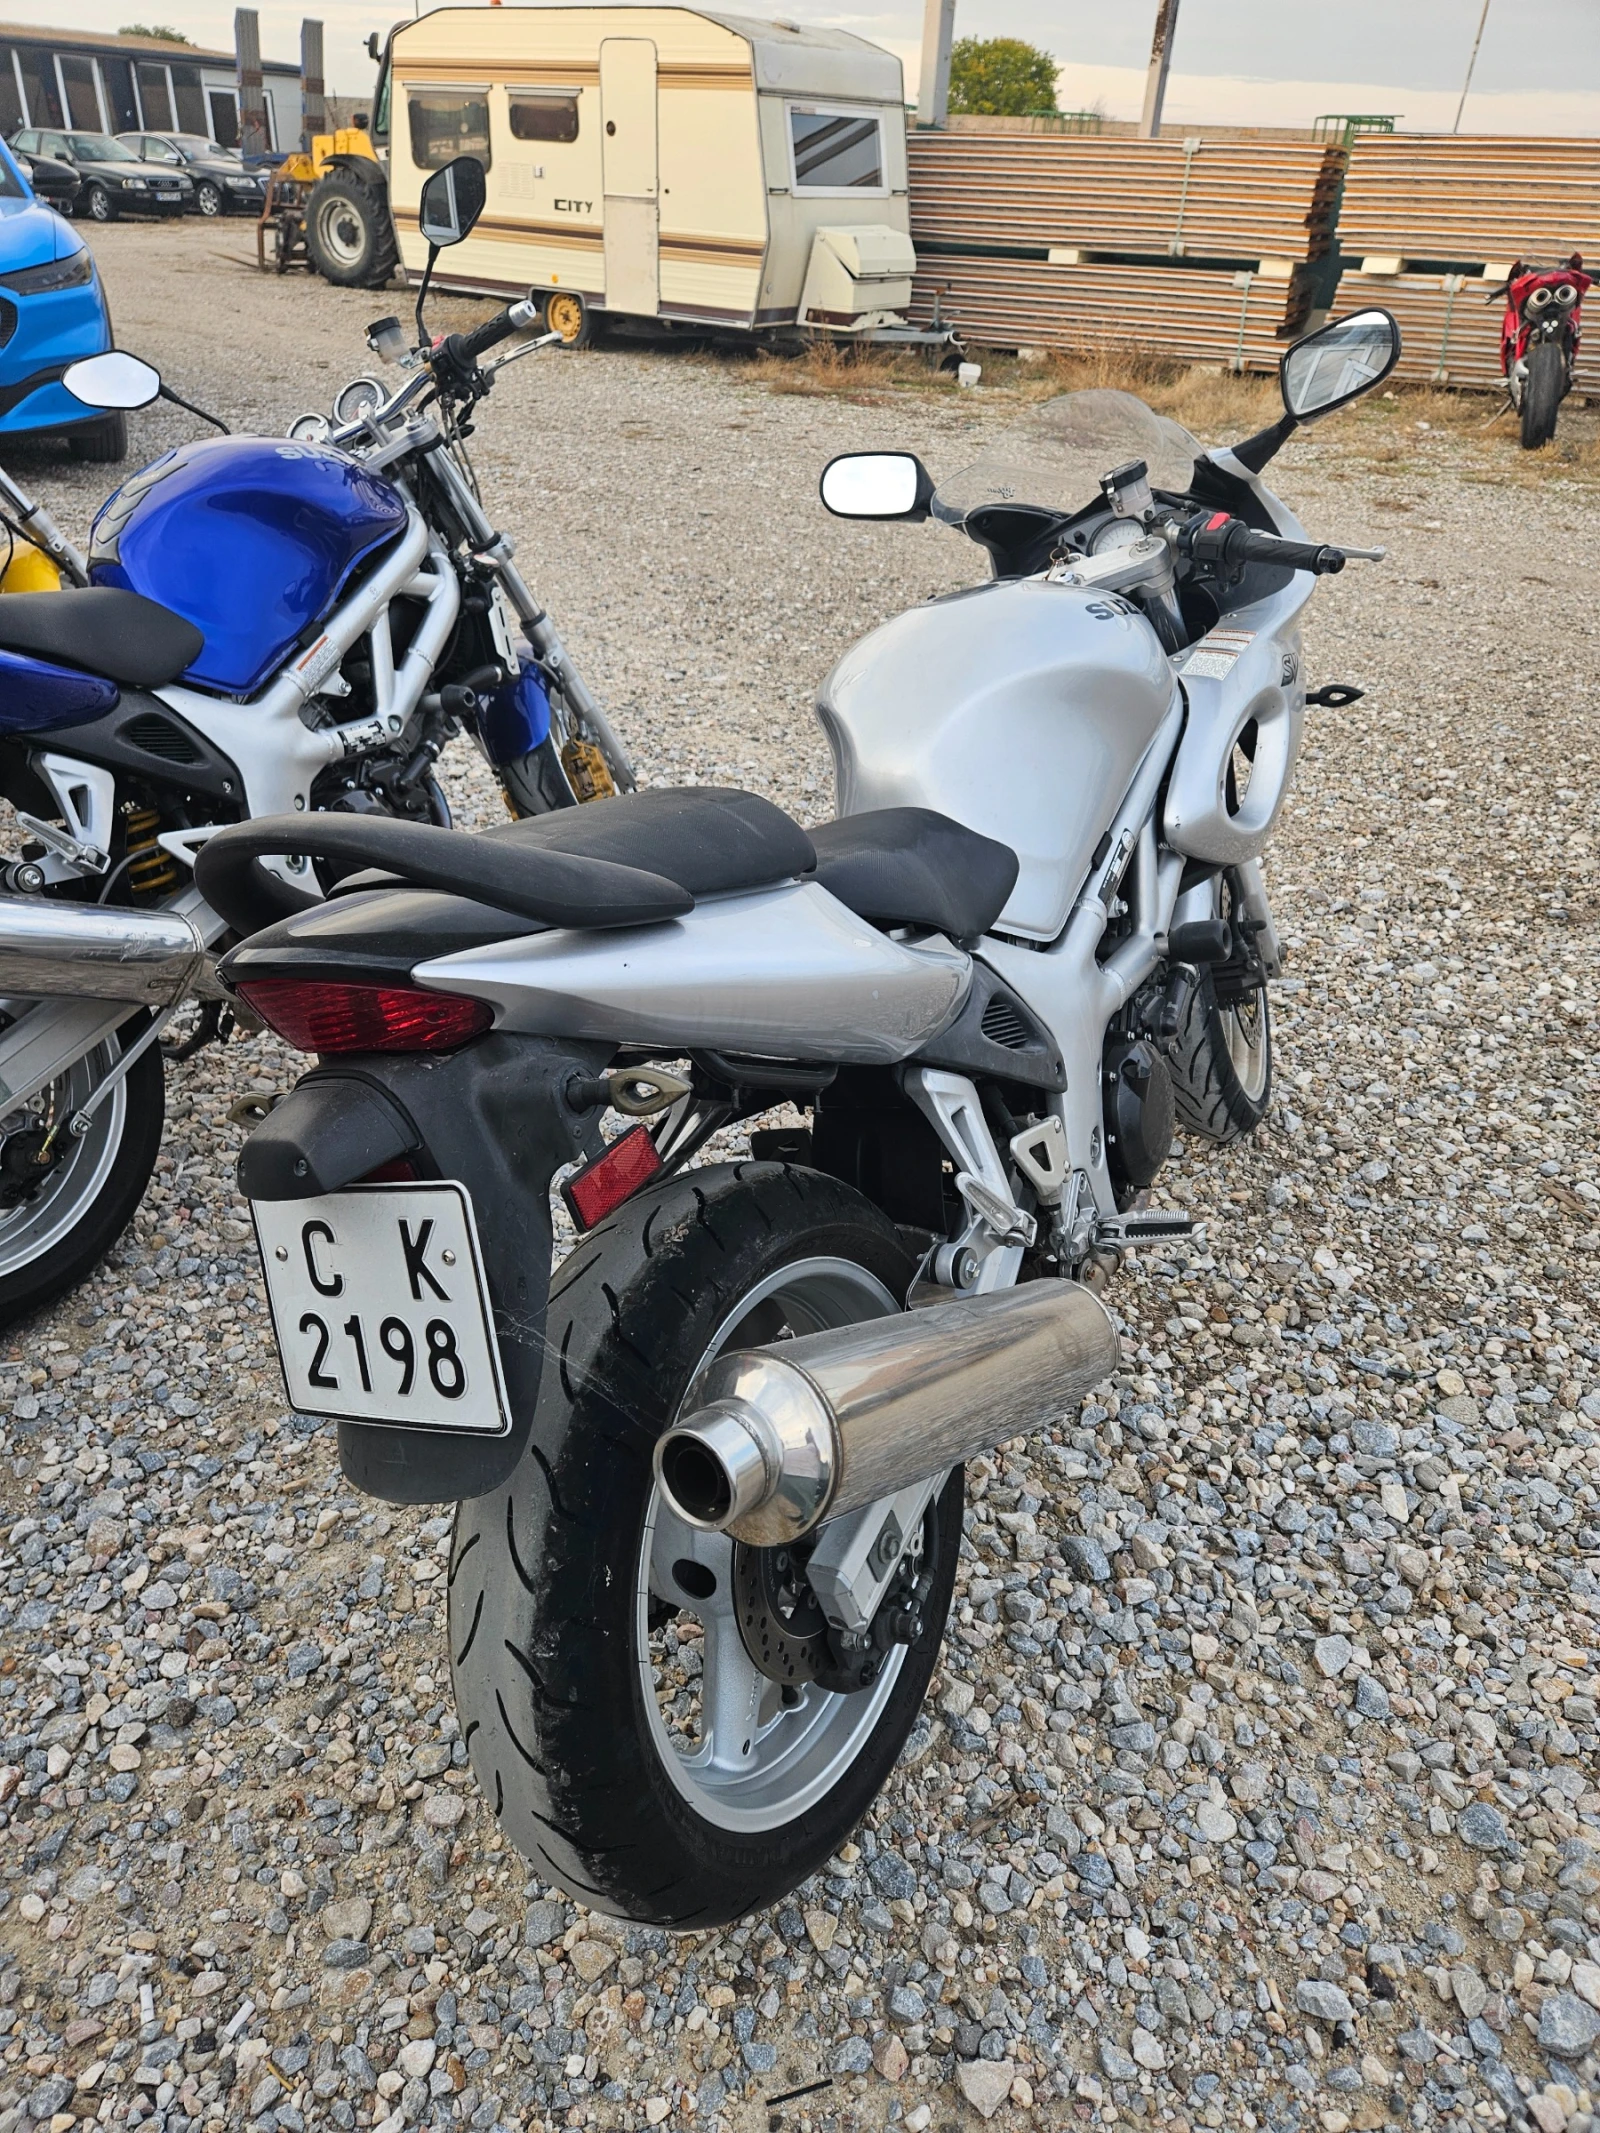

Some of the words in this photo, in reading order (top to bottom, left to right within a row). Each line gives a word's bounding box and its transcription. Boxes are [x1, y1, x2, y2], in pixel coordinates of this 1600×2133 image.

[554, 199, 593, 213] CITY
[302, 1220, 343, 1297] C
[398, 1219, 452, 1301] K
[299, 1312, 466, 1399] 2198
